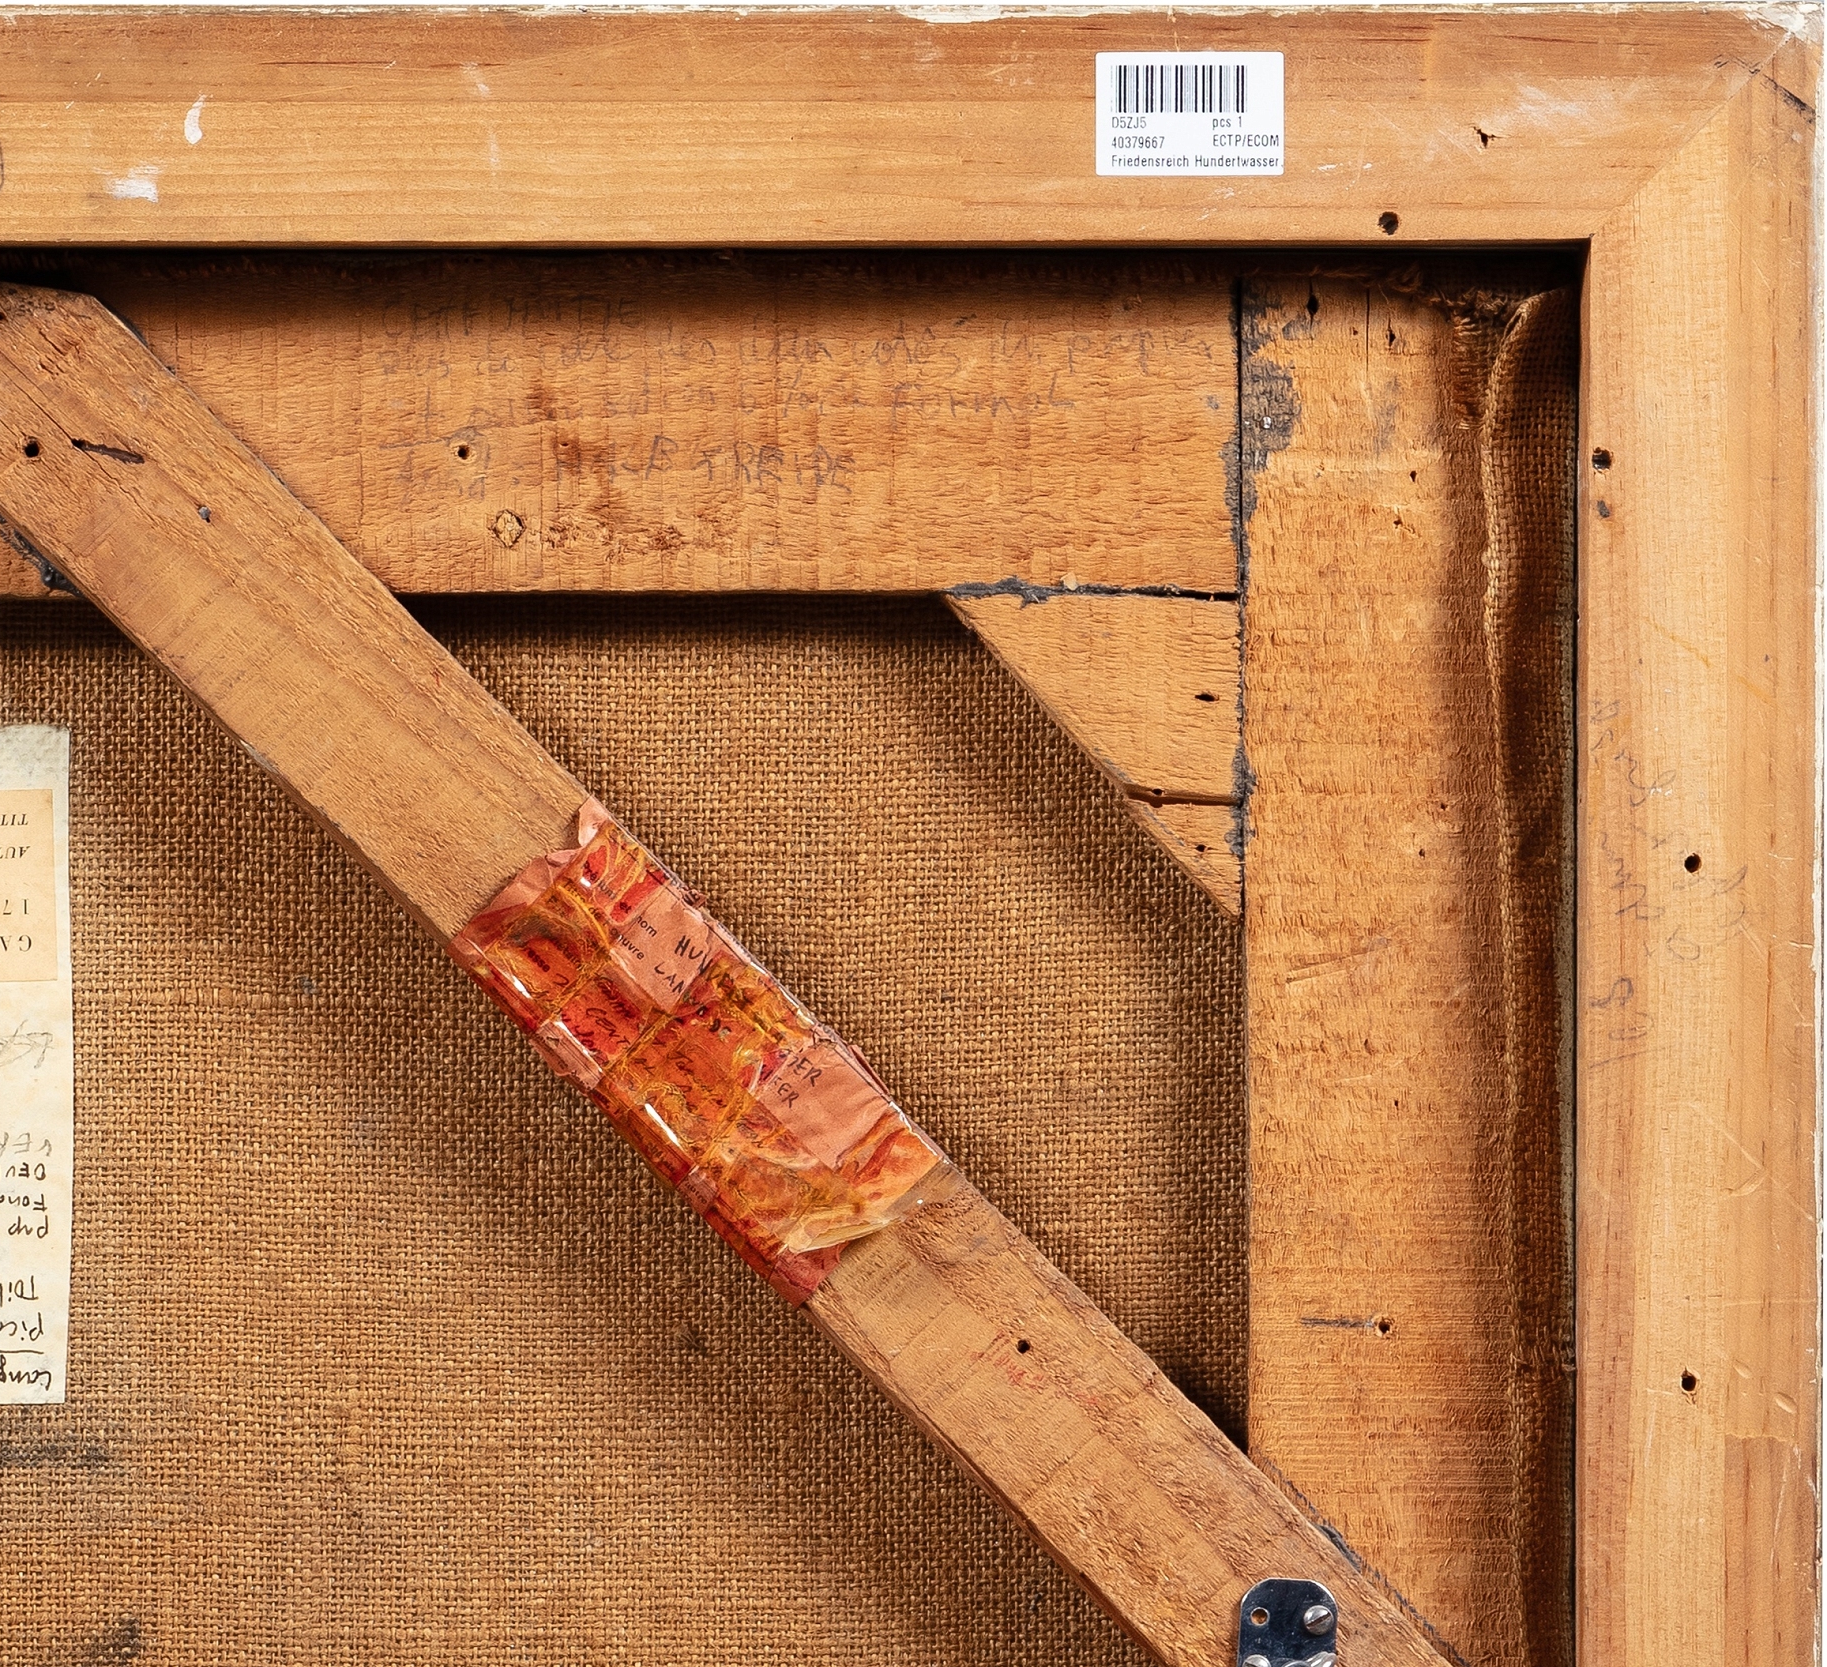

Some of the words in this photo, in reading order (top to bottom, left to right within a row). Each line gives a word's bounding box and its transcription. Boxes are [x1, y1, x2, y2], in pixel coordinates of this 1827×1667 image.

[1112, 117, 1147, 128] D5ZJ5
[1212, 117, 1231, 130] pcs
[1112, 136, 1165, 148] 40379667
[1213, 135, 1279, 146] ECTP/ECOM
[1112, 155, 1189, 167] Friedensreich
[0, 898, 29, 917] 17
